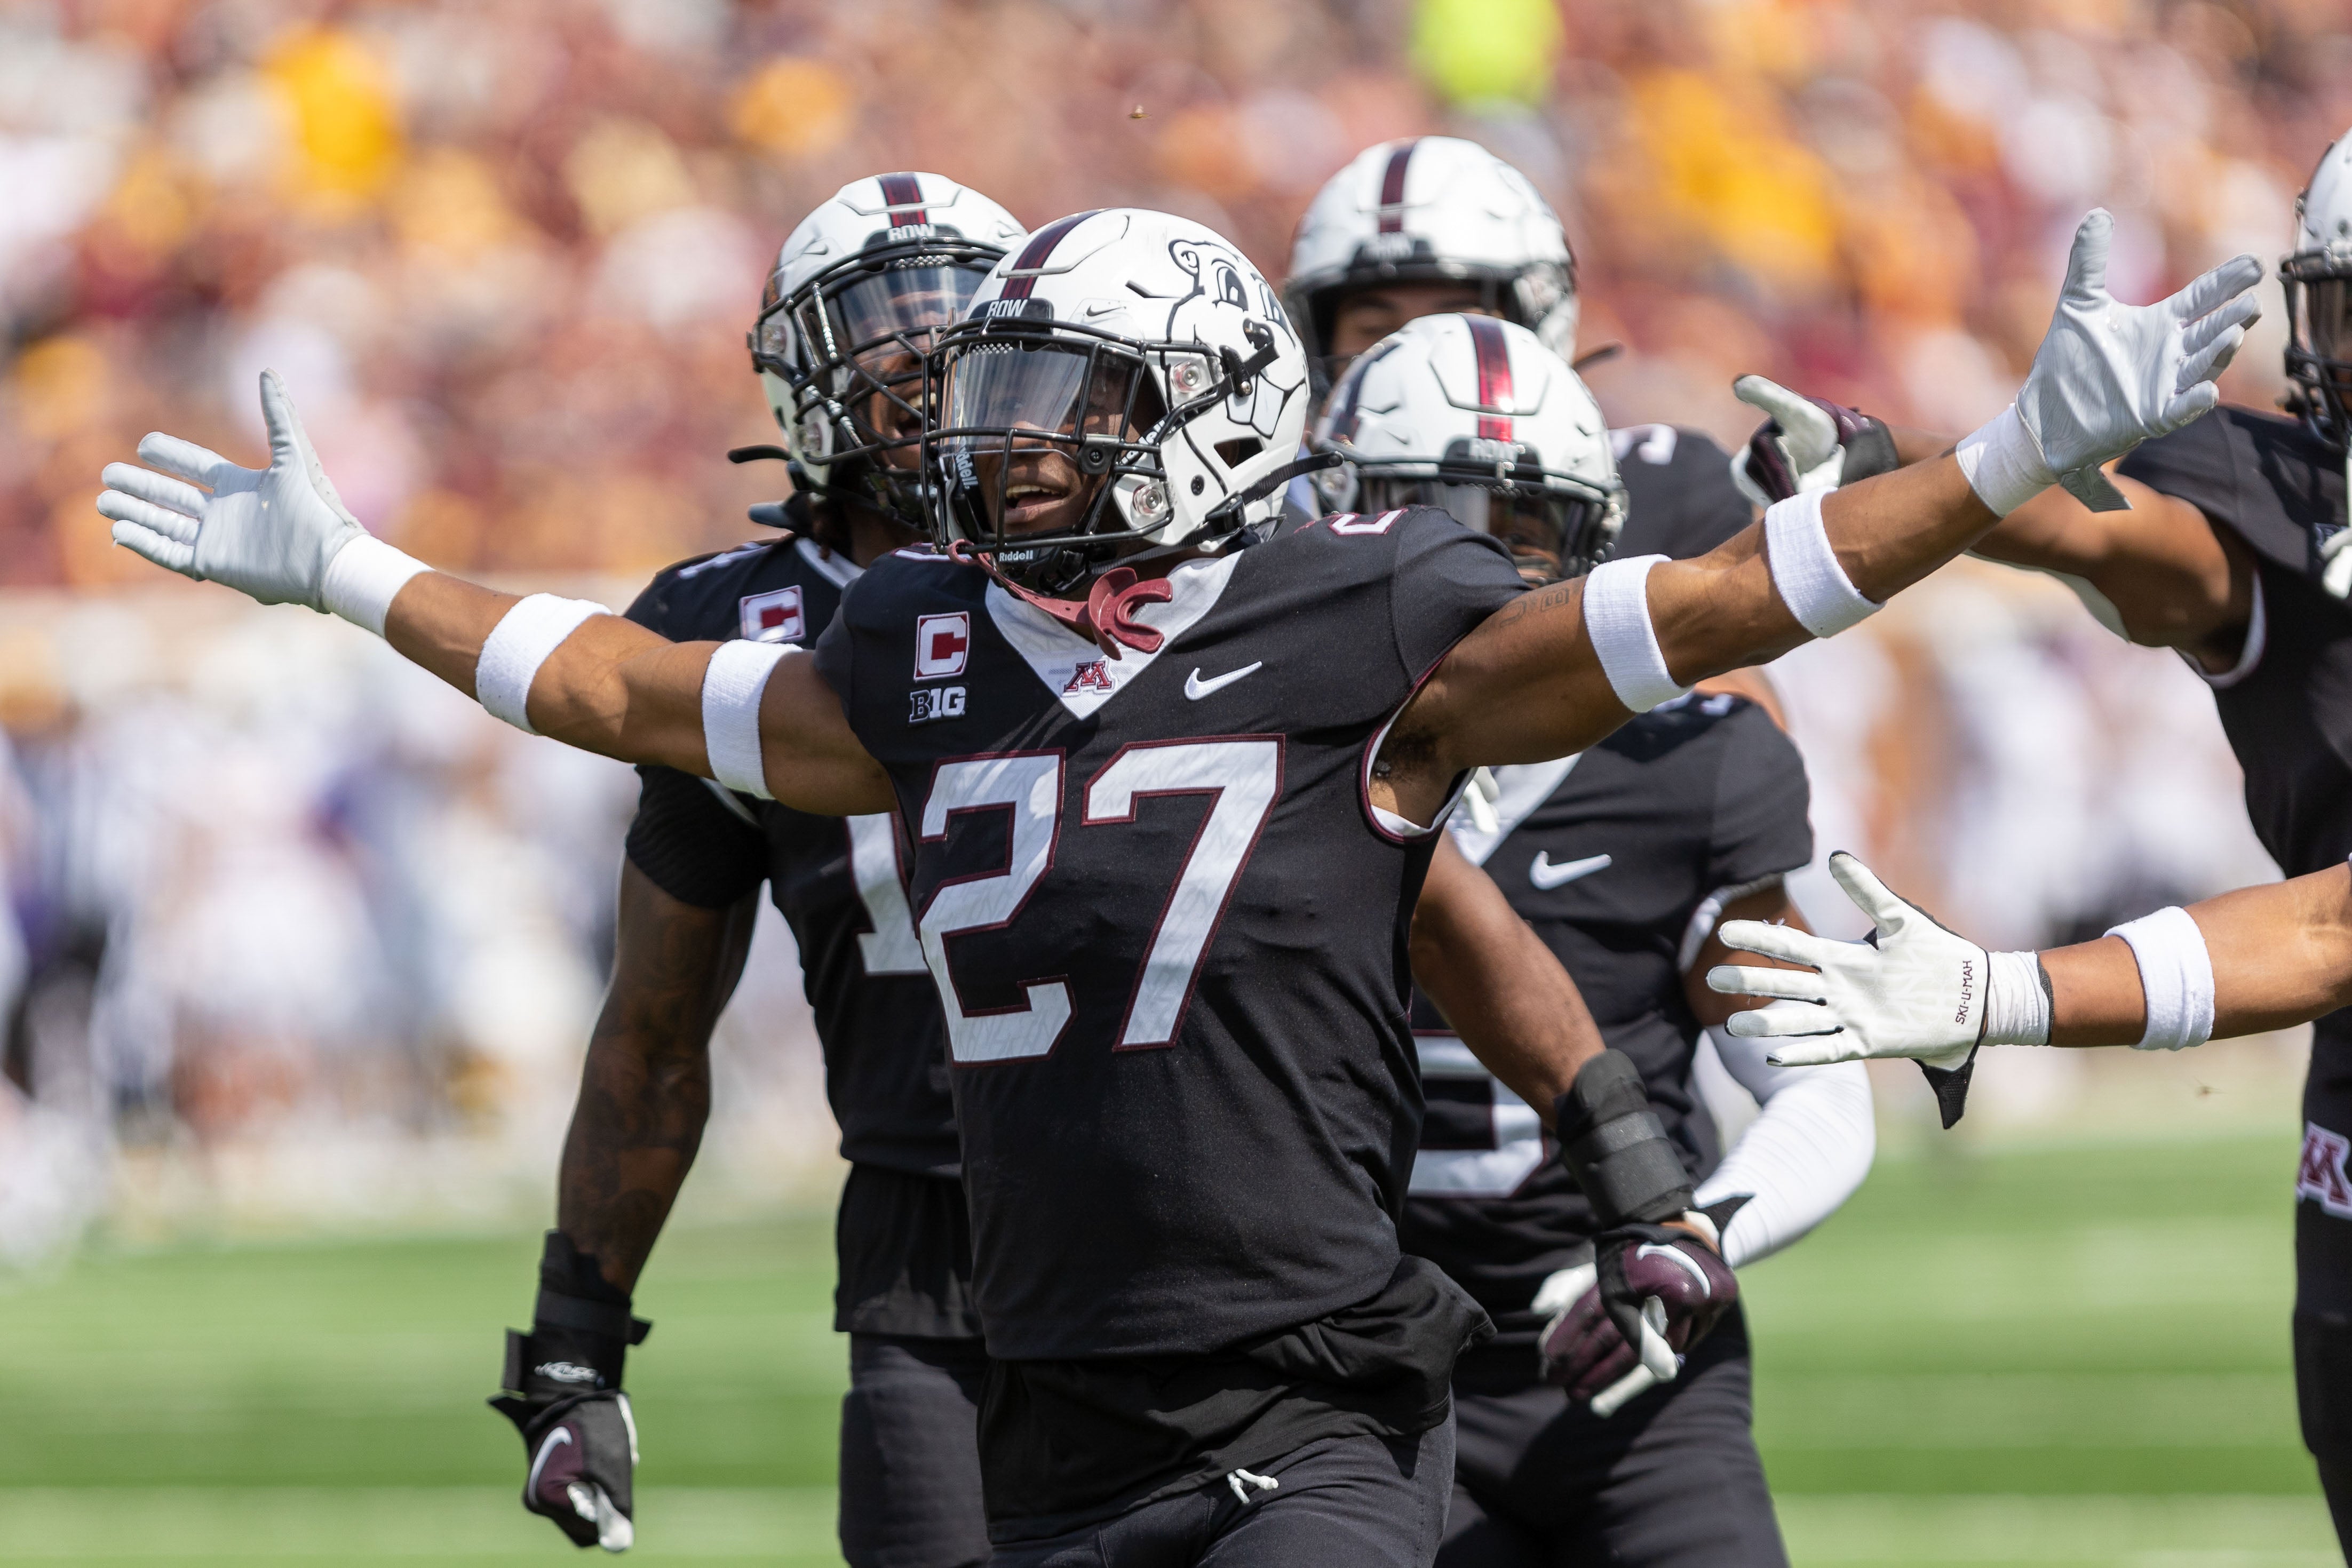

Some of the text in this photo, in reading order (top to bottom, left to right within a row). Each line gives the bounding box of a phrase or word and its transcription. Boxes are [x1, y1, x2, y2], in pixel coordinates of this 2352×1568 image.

[888, 223, 935, 243] ROW
[986, 299, 1028, 318] ROW
[999, 550, 1034, 561] Riddell
[745, 590, 799, 642] C
[918, 616, 966, 675] C
[1062, 660, 1113, 693] M
[915, 733, 1285, 1067] 27
[1955, 960, 1973, 1025] SKI-U-MAH
